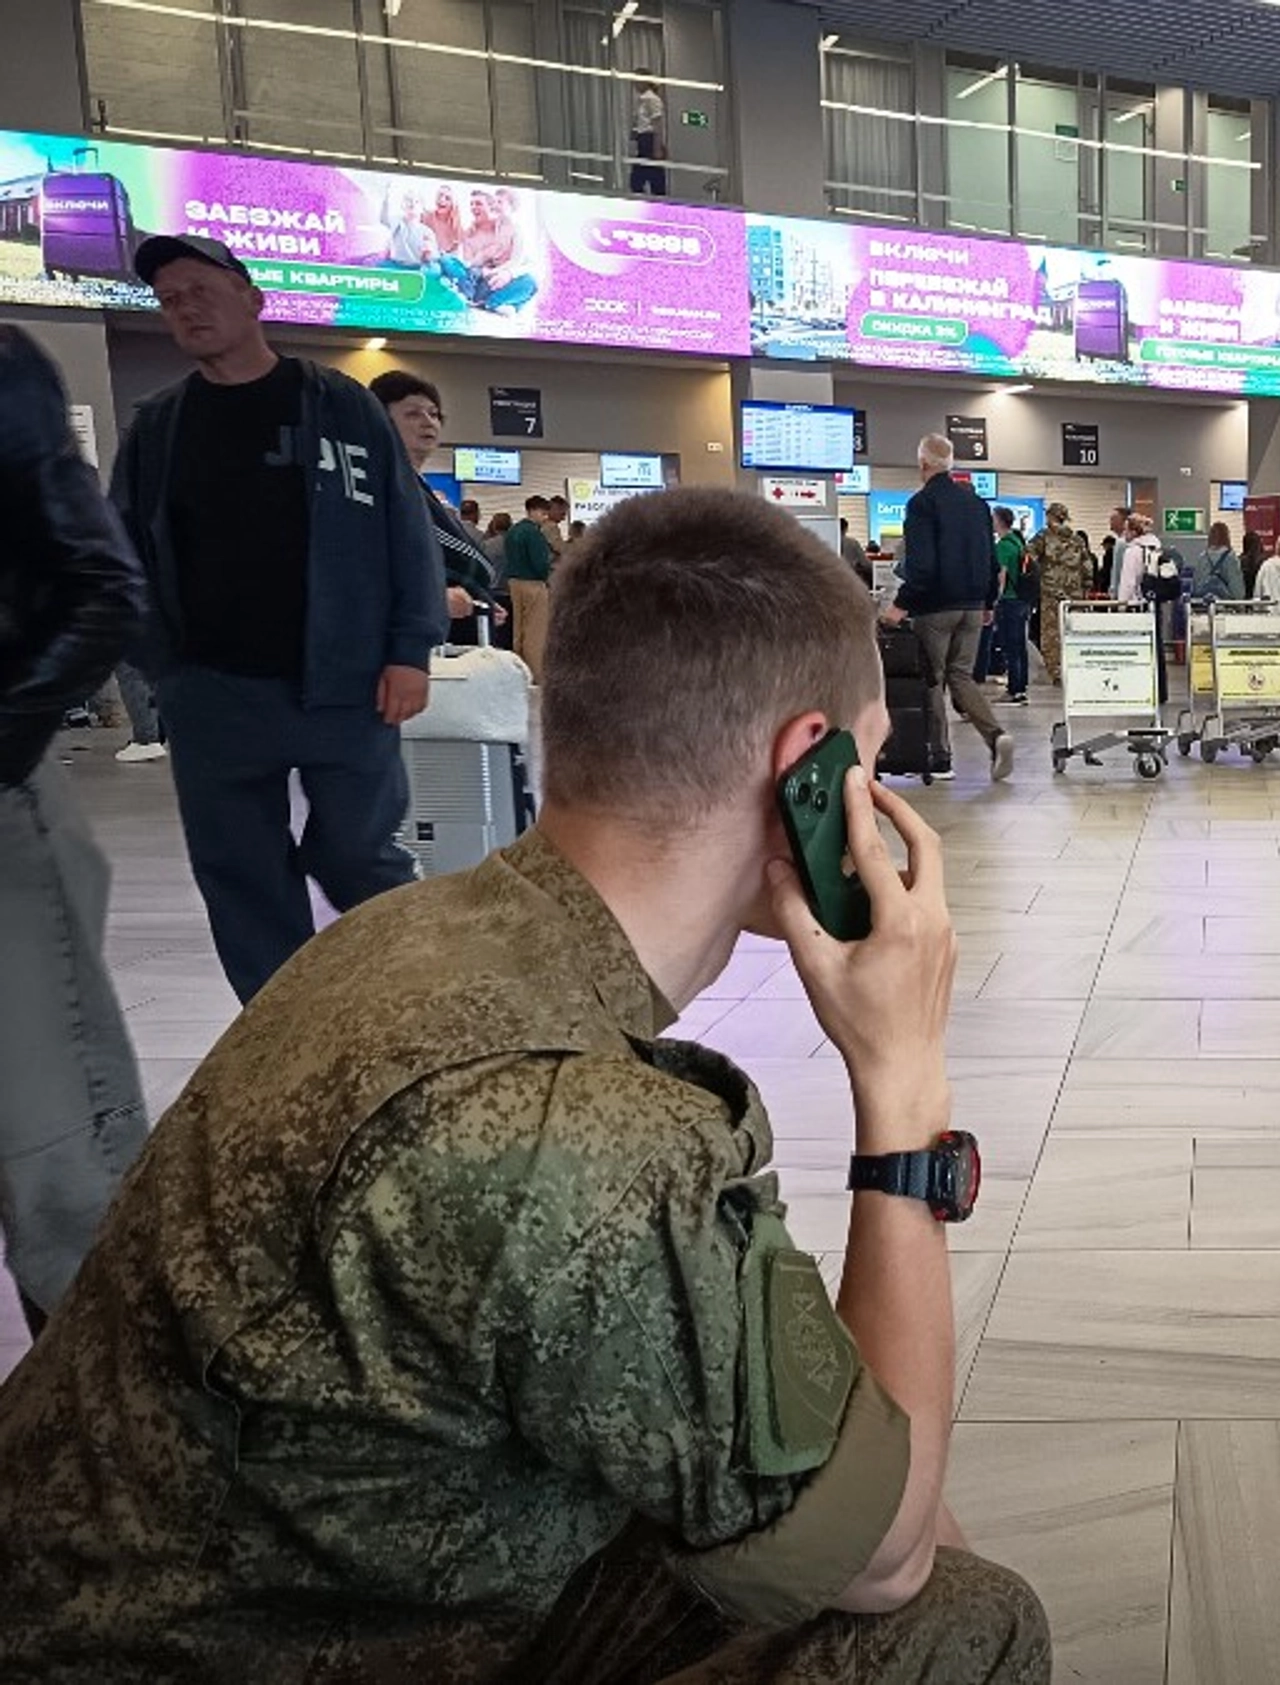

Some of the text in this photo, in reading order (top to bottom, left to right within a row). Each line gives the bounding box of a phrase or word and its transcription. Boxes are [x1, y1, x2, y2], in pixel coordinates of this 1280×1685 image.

[184, 200, 347, 234] ЗАЕЗЖАЙ
[223, 229, 321, 256] ЖИВИ
[870, 241, 969, 264] ВКЛЮЧИ
[291, 271, 400, 292] КВАРТИРЫ
[525, 417, 536, 434] 7
[973, 443, 984, 457] 9
[1079, 450, 1096, 464] 10
